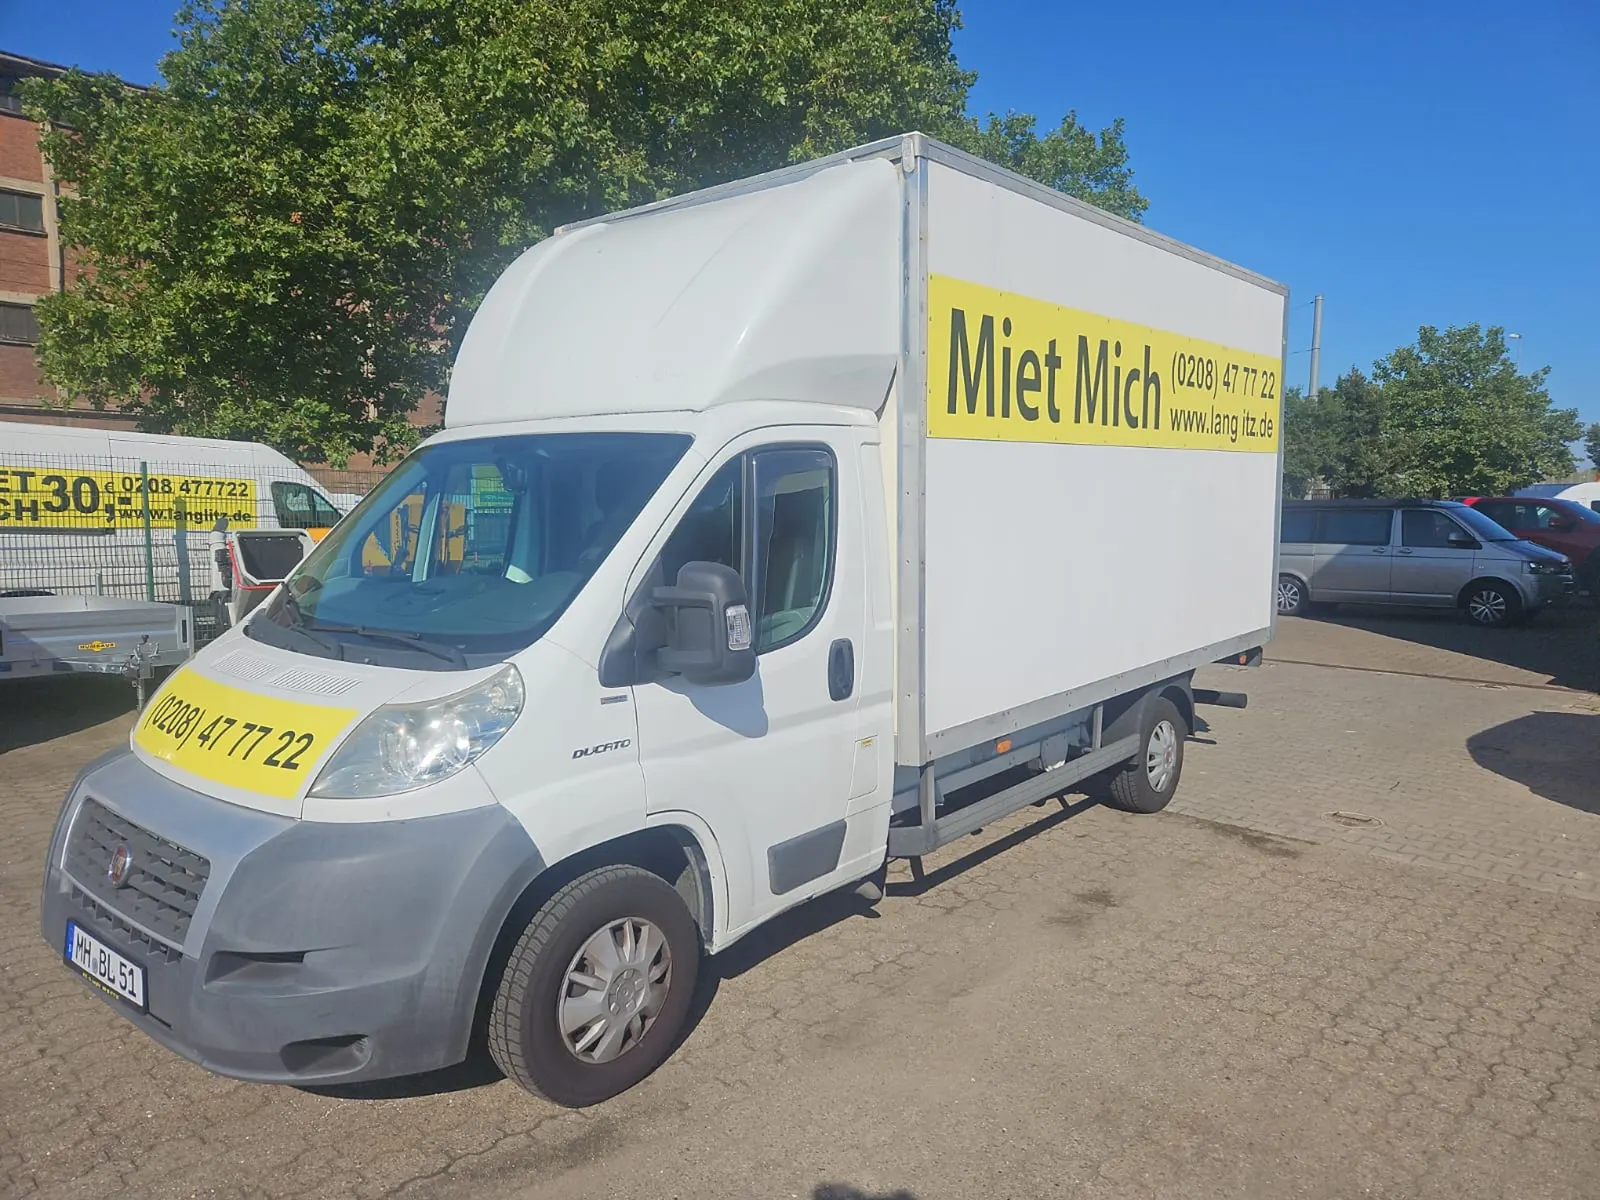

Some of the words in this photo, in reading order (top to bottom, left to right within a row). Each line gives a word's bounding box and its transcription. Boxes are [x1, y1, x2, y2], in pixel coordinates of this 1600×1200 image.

[947, 307, 1062, 424] Miet
[1073, 334, 1161, 431] Mich
[1171, 351, 1218, 400] (0208)
[1222, 362, 1239, 394] 47
[1243, 366, 1258, 397] 77
[1260, 370, 1275, 399] 22
[122, 476, 172, 493] 0208
[179, 479, 249, 497] 477722
[144, 692, 207, 751] (0208)
[198, 714, 238, 751] 47
[227, 722, 273, 761] 77
[263, 730, 314, 771] 22
[572, 738, 631, 760] DUCATO
[76, 932, 92, 969] MH
[99, 948, 116, 985] BL
[119, 961, 137, 998] 51
